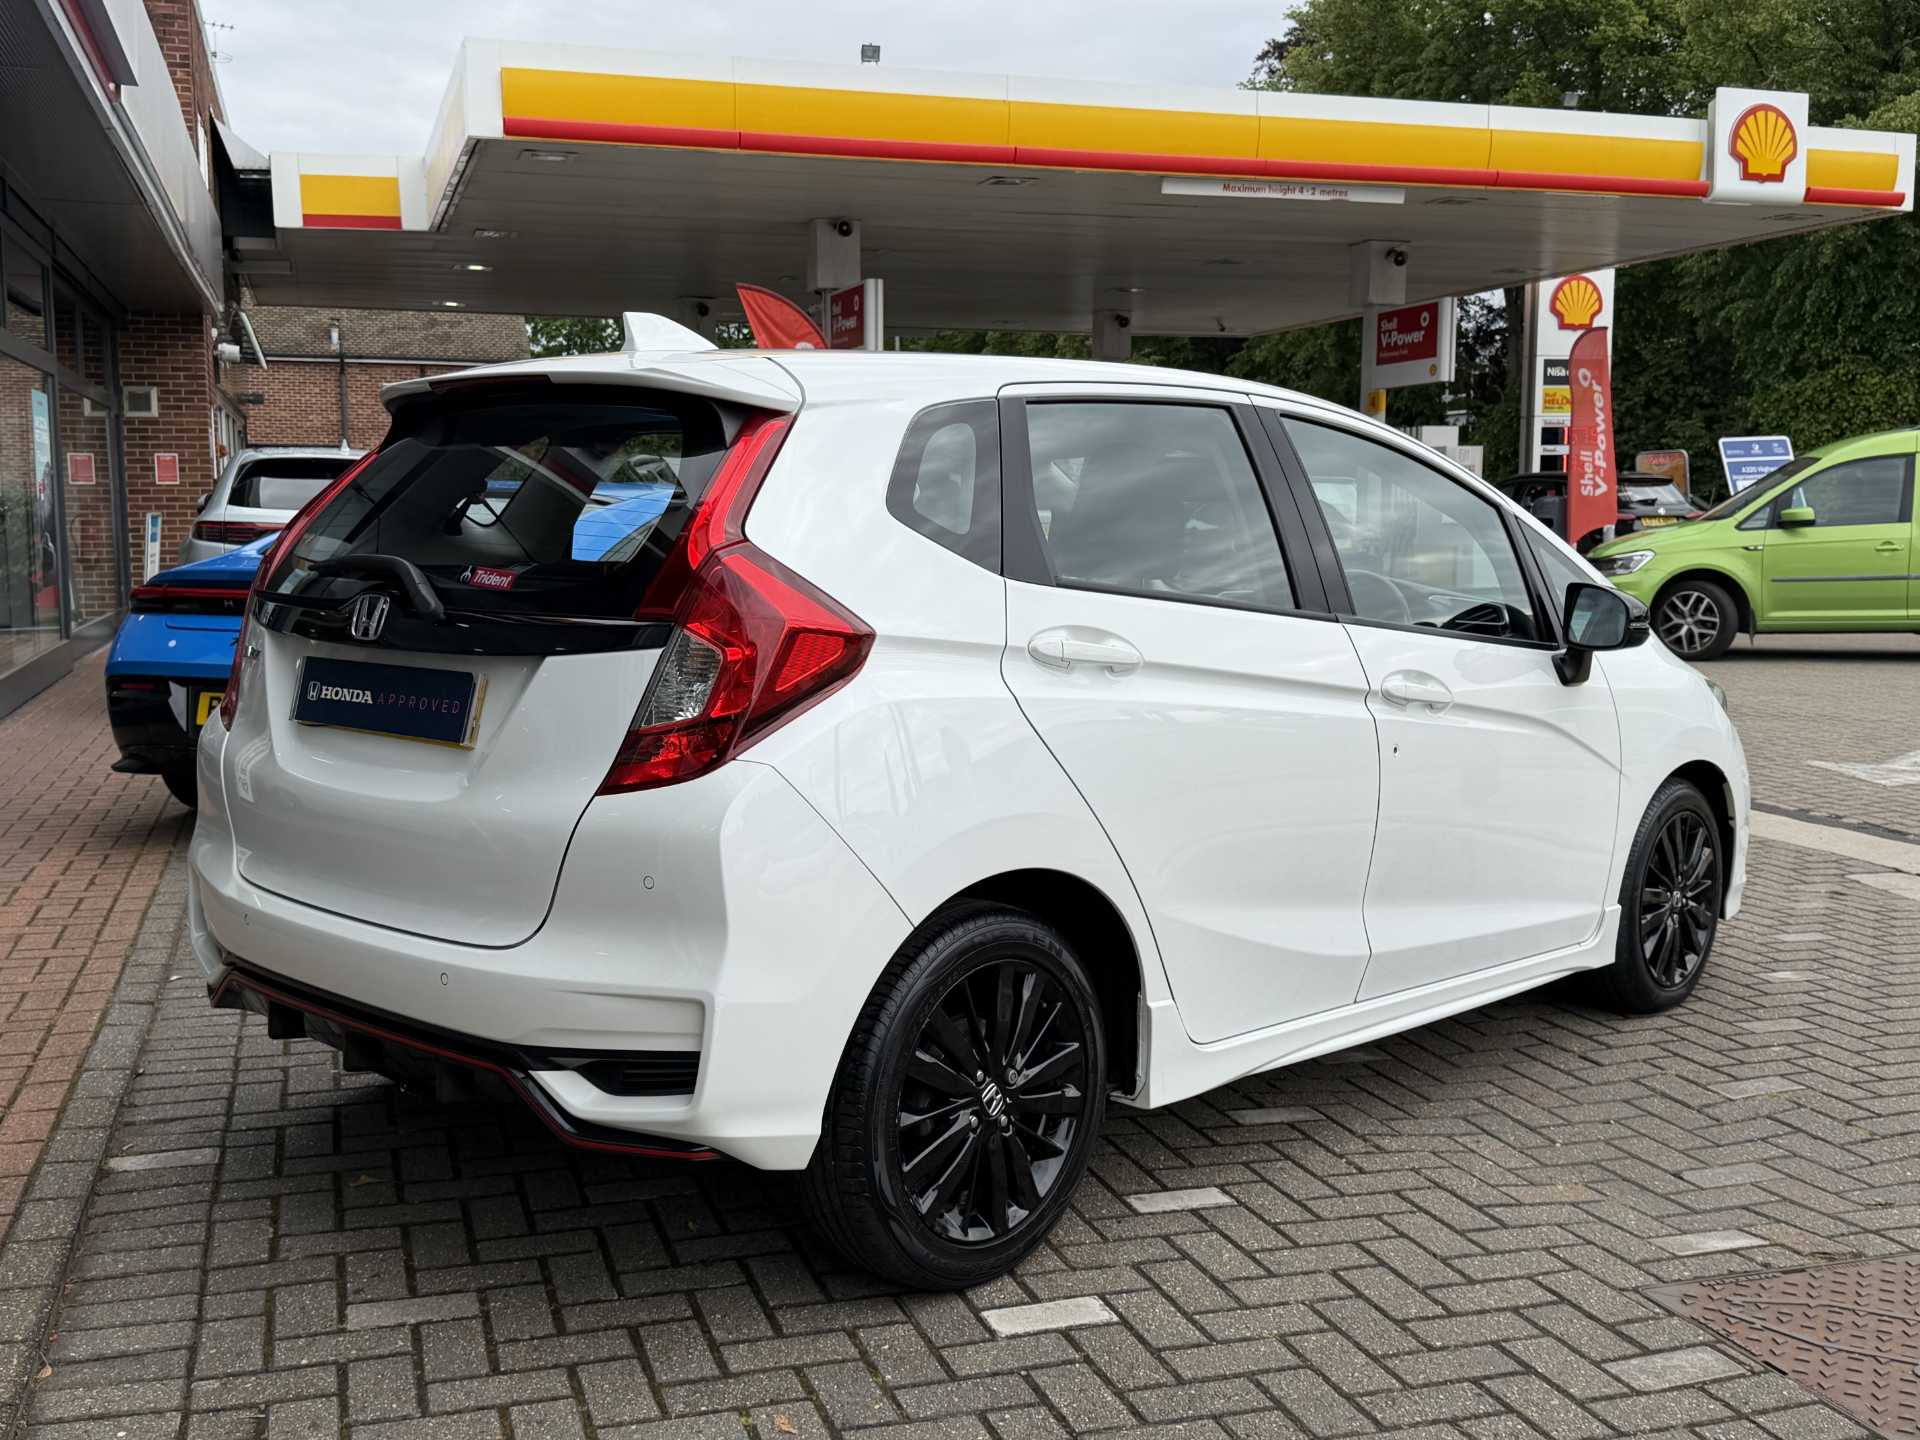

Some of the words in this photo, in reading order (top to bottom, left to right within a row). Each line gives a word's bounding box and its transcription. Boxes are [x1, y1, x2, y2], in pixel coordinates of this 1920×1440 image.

[1222, 183, 1266, 193] Maximum
[1268, 184, 1296, 195] height
[1320, 188, 1348, 197] metres
[1381, 317, 1399, 332] Shell
[1380, 330, 1425, 348] V-Power
[1546, 366, 1566, 377] Nisa
[1591, 379, 1608, 496] V-Power
[1580, 450, 1594, 496] Shell
[473, 569, 513, 588] Trident
[319, 685, 374, 705] HONDA
[377, 692, 461, 714] APPROVED
